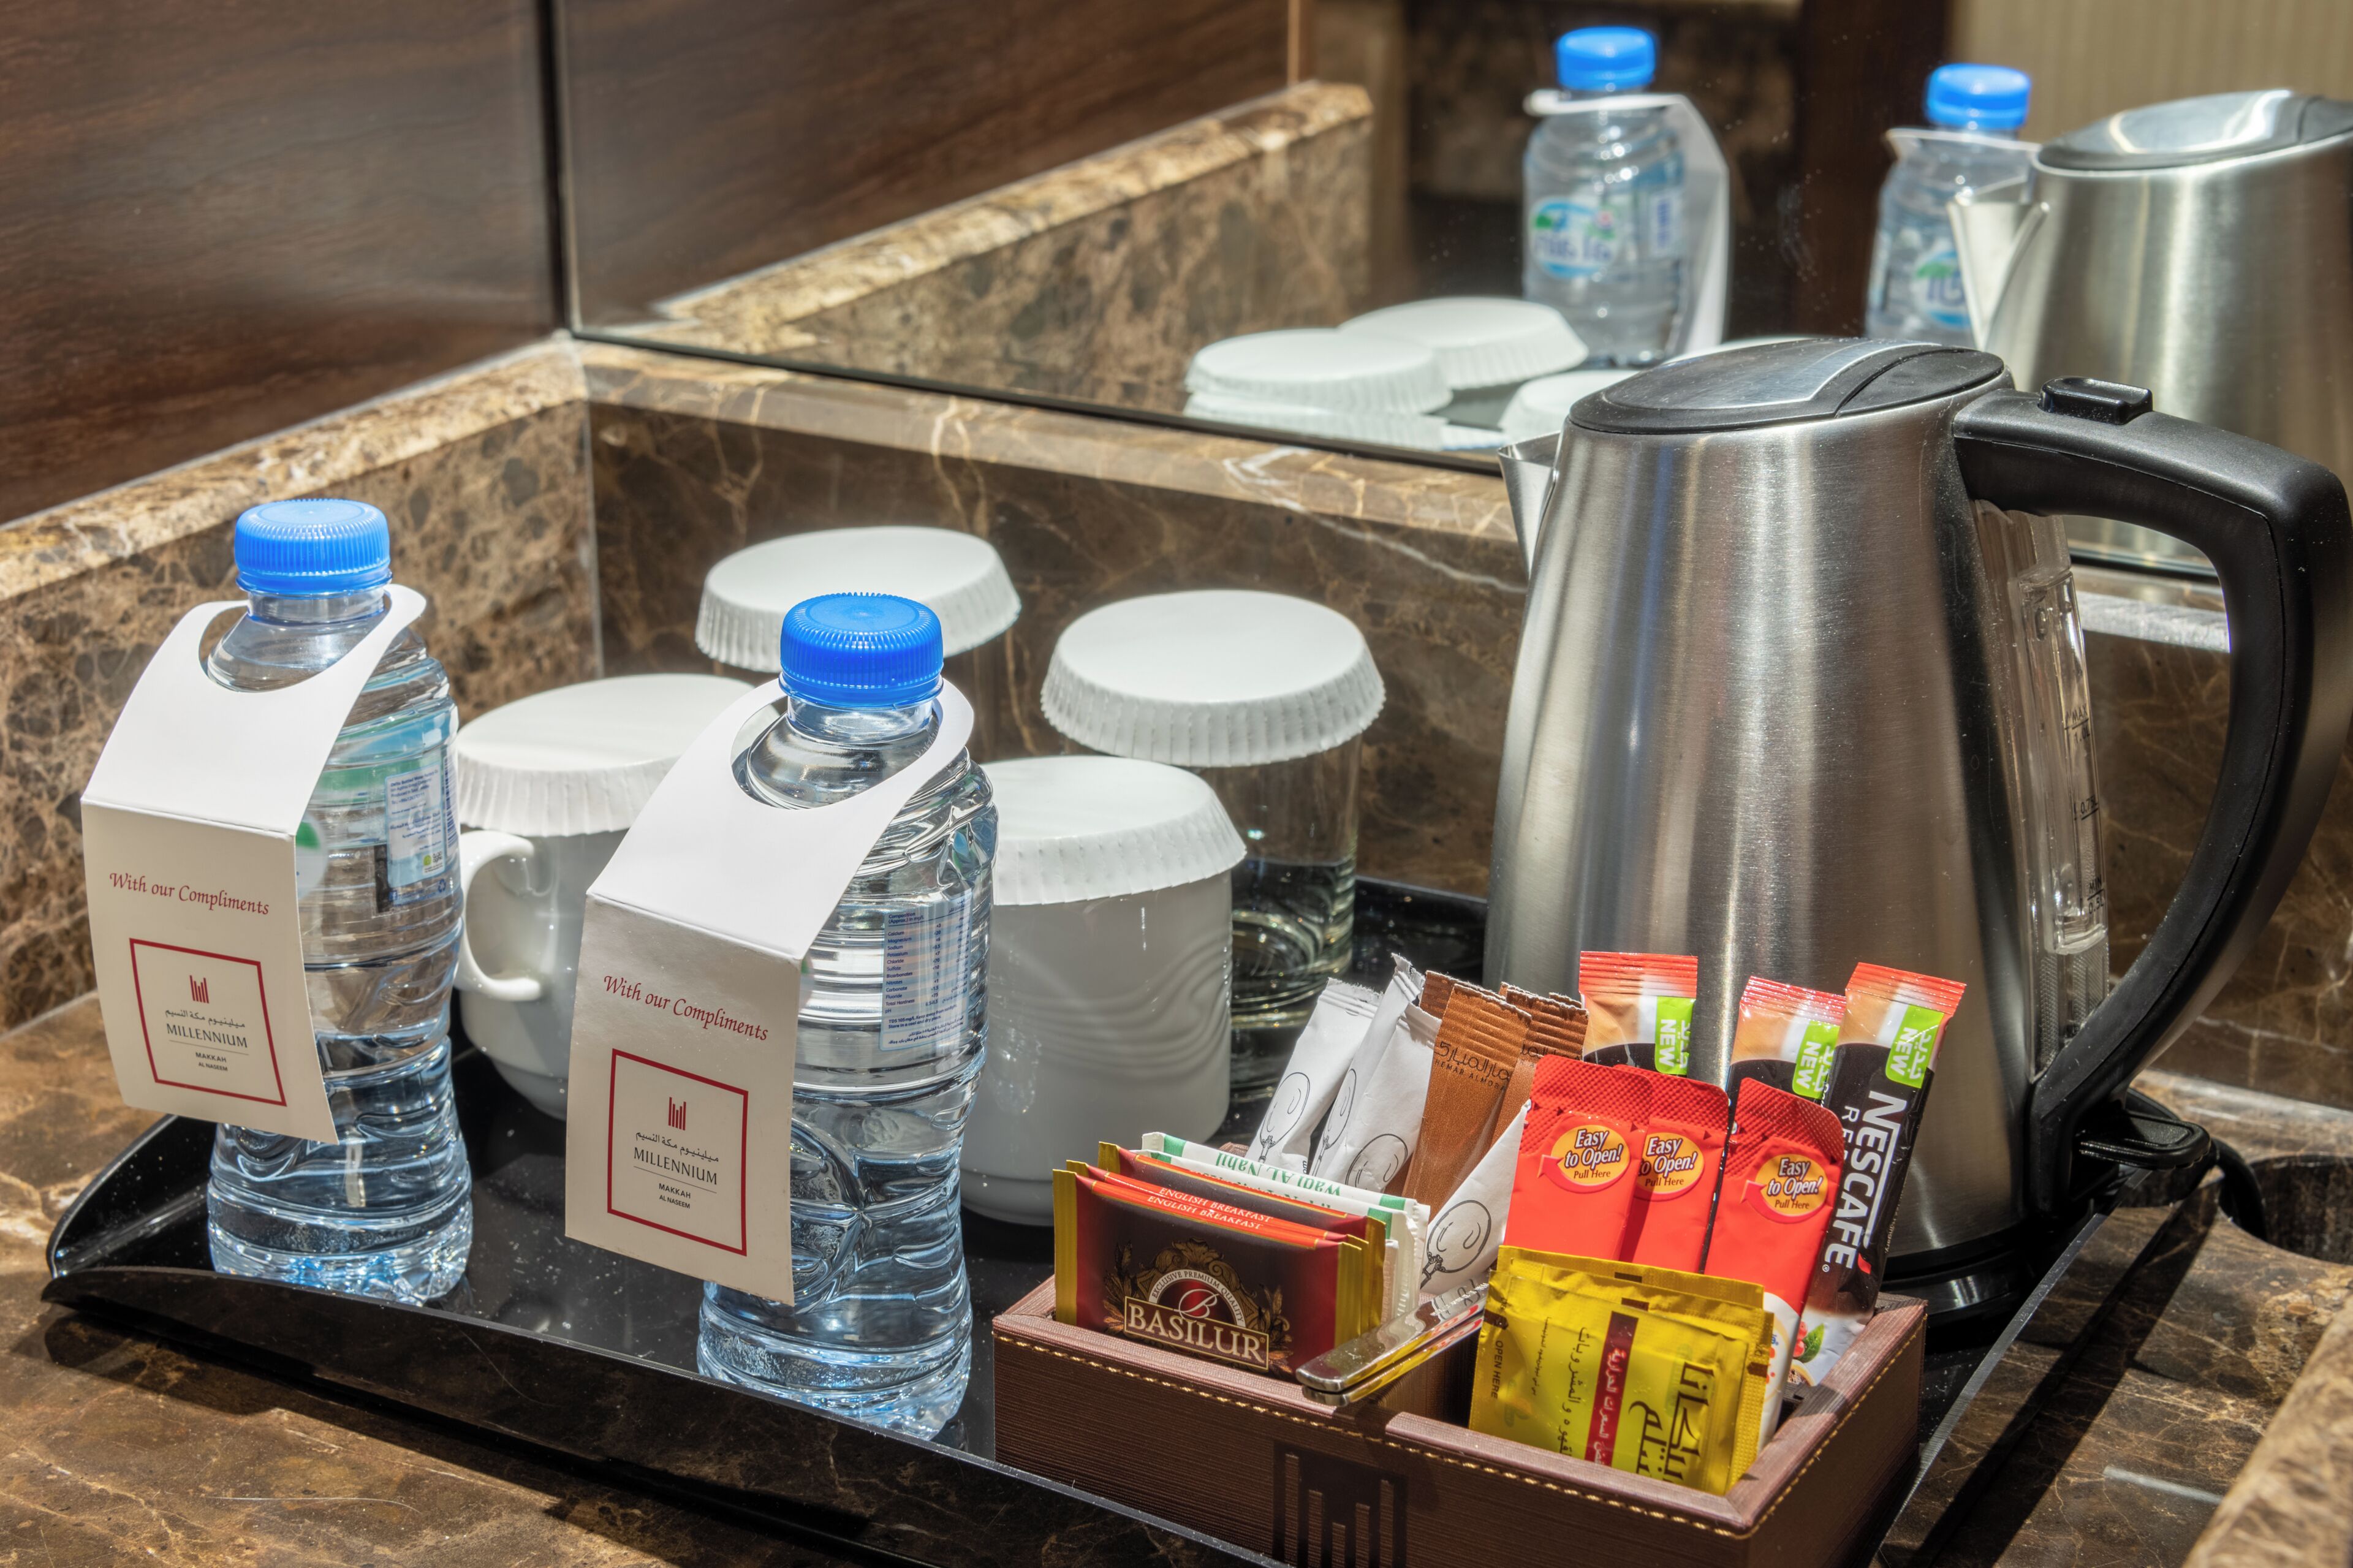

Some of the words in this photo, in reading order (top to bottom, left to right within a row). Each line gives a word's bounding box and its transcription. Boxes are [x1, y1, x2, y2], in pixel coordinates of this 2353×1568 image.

[109, 873, 147, 893] With
[151, 884, 175, 897] our
[178, 885, 270, 915] Compliments
[165, 1009, 188, 1018] النسيم
[190, 1011, 205, 1020] مكة
[604, 975, 642, 1001] With
[645, 993, 670, 1010] our
[673, 999, 768, 1040] Compliments
[166, 1023, 248, 1048] MILLENNIUM
[208, 1018, 246, 1029] ميلينيوم
[1658, 1019, 1677, 1067] NEW
[1890, 1027, 1918, 1076] NEW
[1908, 1031, 1932, 1080] جديد
[195, 1051, 227, 1062] MAKKAH
[205, 1062, 229, 1072] NASEEM
[1435, 1059, 1464, 1075] HEMAR
[1795, 1041, 1822, 1089] NEW
[635, 1132, 660, 1143] النسيم
[661, 1136, 678, 1148] مكة
[1574, 1129, 1608, 1149] Easy
[1842, 1105, 1860, 1161] RE
[680, 1146, 719, 1162] ميلينيوم
[1564, 1150, 1579, 1168] to
[1581, 1143, 1624, 1171] Open!
[1646, 1137, 1683, 1158] Easy
[634, 1146, 717, 1185] MILLENNIUM
[1574, 1170, 1591, 1179] Pull
[1592, 1169, 1611, 1178] Here
[1653, 1151, 1699, 1178] Open!
[1778, 1157, 1811, 1180] Easy
[659, 1183, 691, 1199] MAKKAH
[1645, 1177, 1662, 1187] Pull
[1664, 1177, 1684, 1186] Here
[1767, 1179, 1782, 1195] to
[1783, 1175, 1824, 1201] Open!
[667, 1196, 691, 1209] NASEEM
[1148, 1195, 1197, 1214] ENGLISH
[1199, 1209, 1264, 1230] BREAKFAST
[1159, 1187, 1208, 1206] ENGLISH
[1210, 1201, 1274, 1223] BREAKFAST
[1775, 1200, 1789, 1208] Pull
[1792, 1200, 1809, 1210] Here
[1151, 1271, 1183, 1299] EXCLUSIVE
[1184, 1270, 1220, 1289] PREMIUM
[1221, 1287, 1244, 1324] QUALITY
[1129, 1303, 1265, 1363] BASILUR
[1494, 1339, 1504, 1369] OPEN
[1491, 1370, 1501, 1399] HERE
